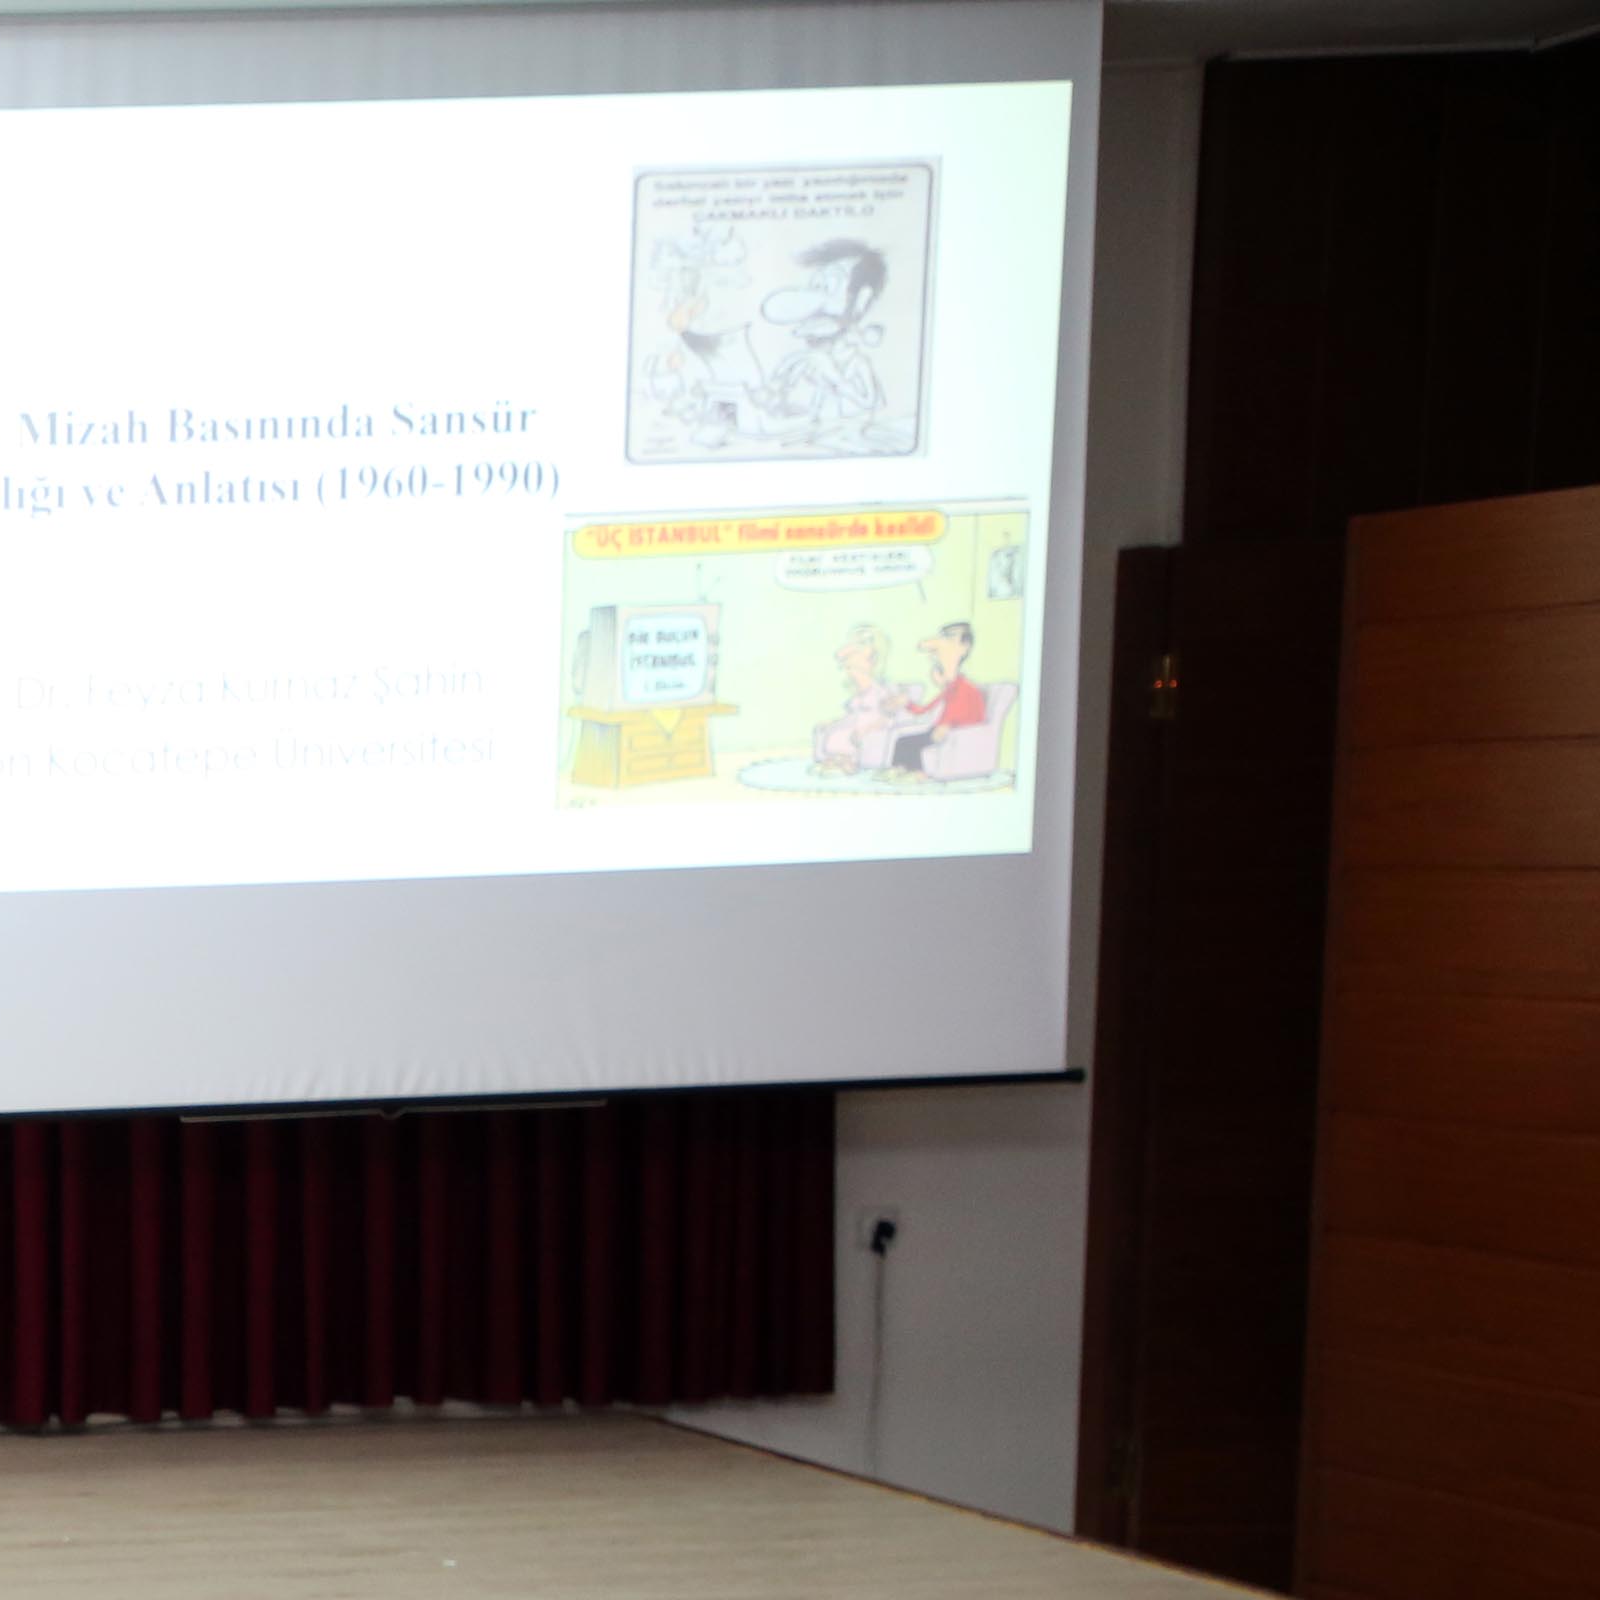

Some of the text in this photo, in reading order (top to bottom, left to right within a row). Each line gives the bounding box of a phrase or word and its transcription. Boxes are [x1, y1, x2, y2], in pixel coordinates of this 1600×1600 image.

[19, 410, 149, 446] Mizah
[167, 403, 374, 442] Basınında
[391, 400, 539, 438] Sansür
[81, 482, 126, 509] ve
[143, 468, 303, 507] Anlatısı
[316, 459, 562, 505] (1960-1990)
[17, 675, 71, 710] Dr.
[48, 743, 257, 779] Kocatepe
[272, 728, 497, 768] Üniversitesi
